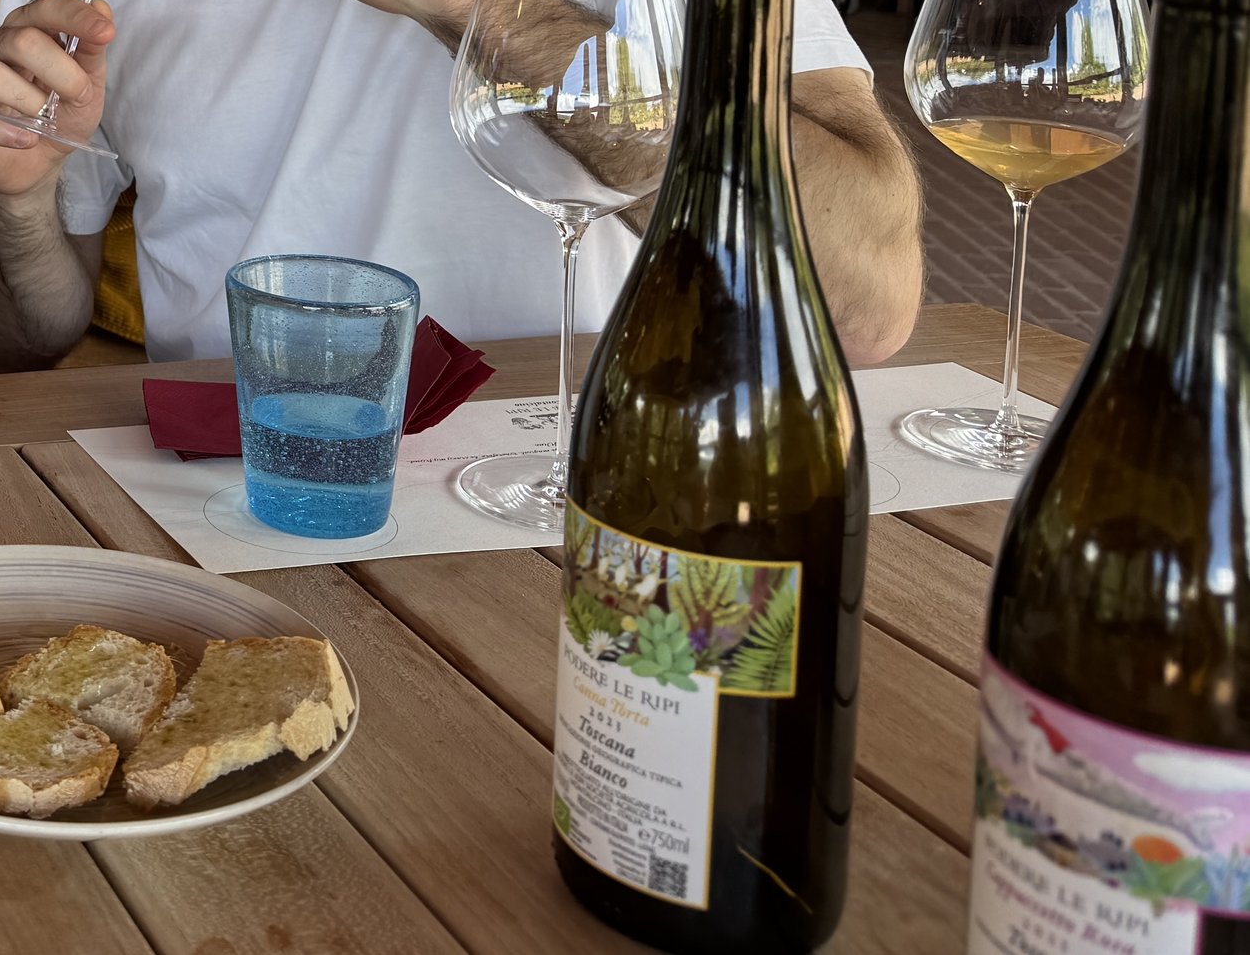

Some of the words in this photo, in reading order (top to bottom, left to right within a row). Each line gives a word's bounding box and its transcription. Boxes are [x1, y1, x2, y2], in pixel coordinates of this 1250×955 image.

[515, 400, 559, 408] ontalcino
[564, 642, 608, 687] PODERE
[613, 679, 635, 700] LE
[640, 690, 680, 715] RIPI
[573, 675, 607, 708] Canna
[610, 697, 650, 726] Torta
[579, 715, 636, 758] Toscana
[579, 749, 628, 789] Bianco
